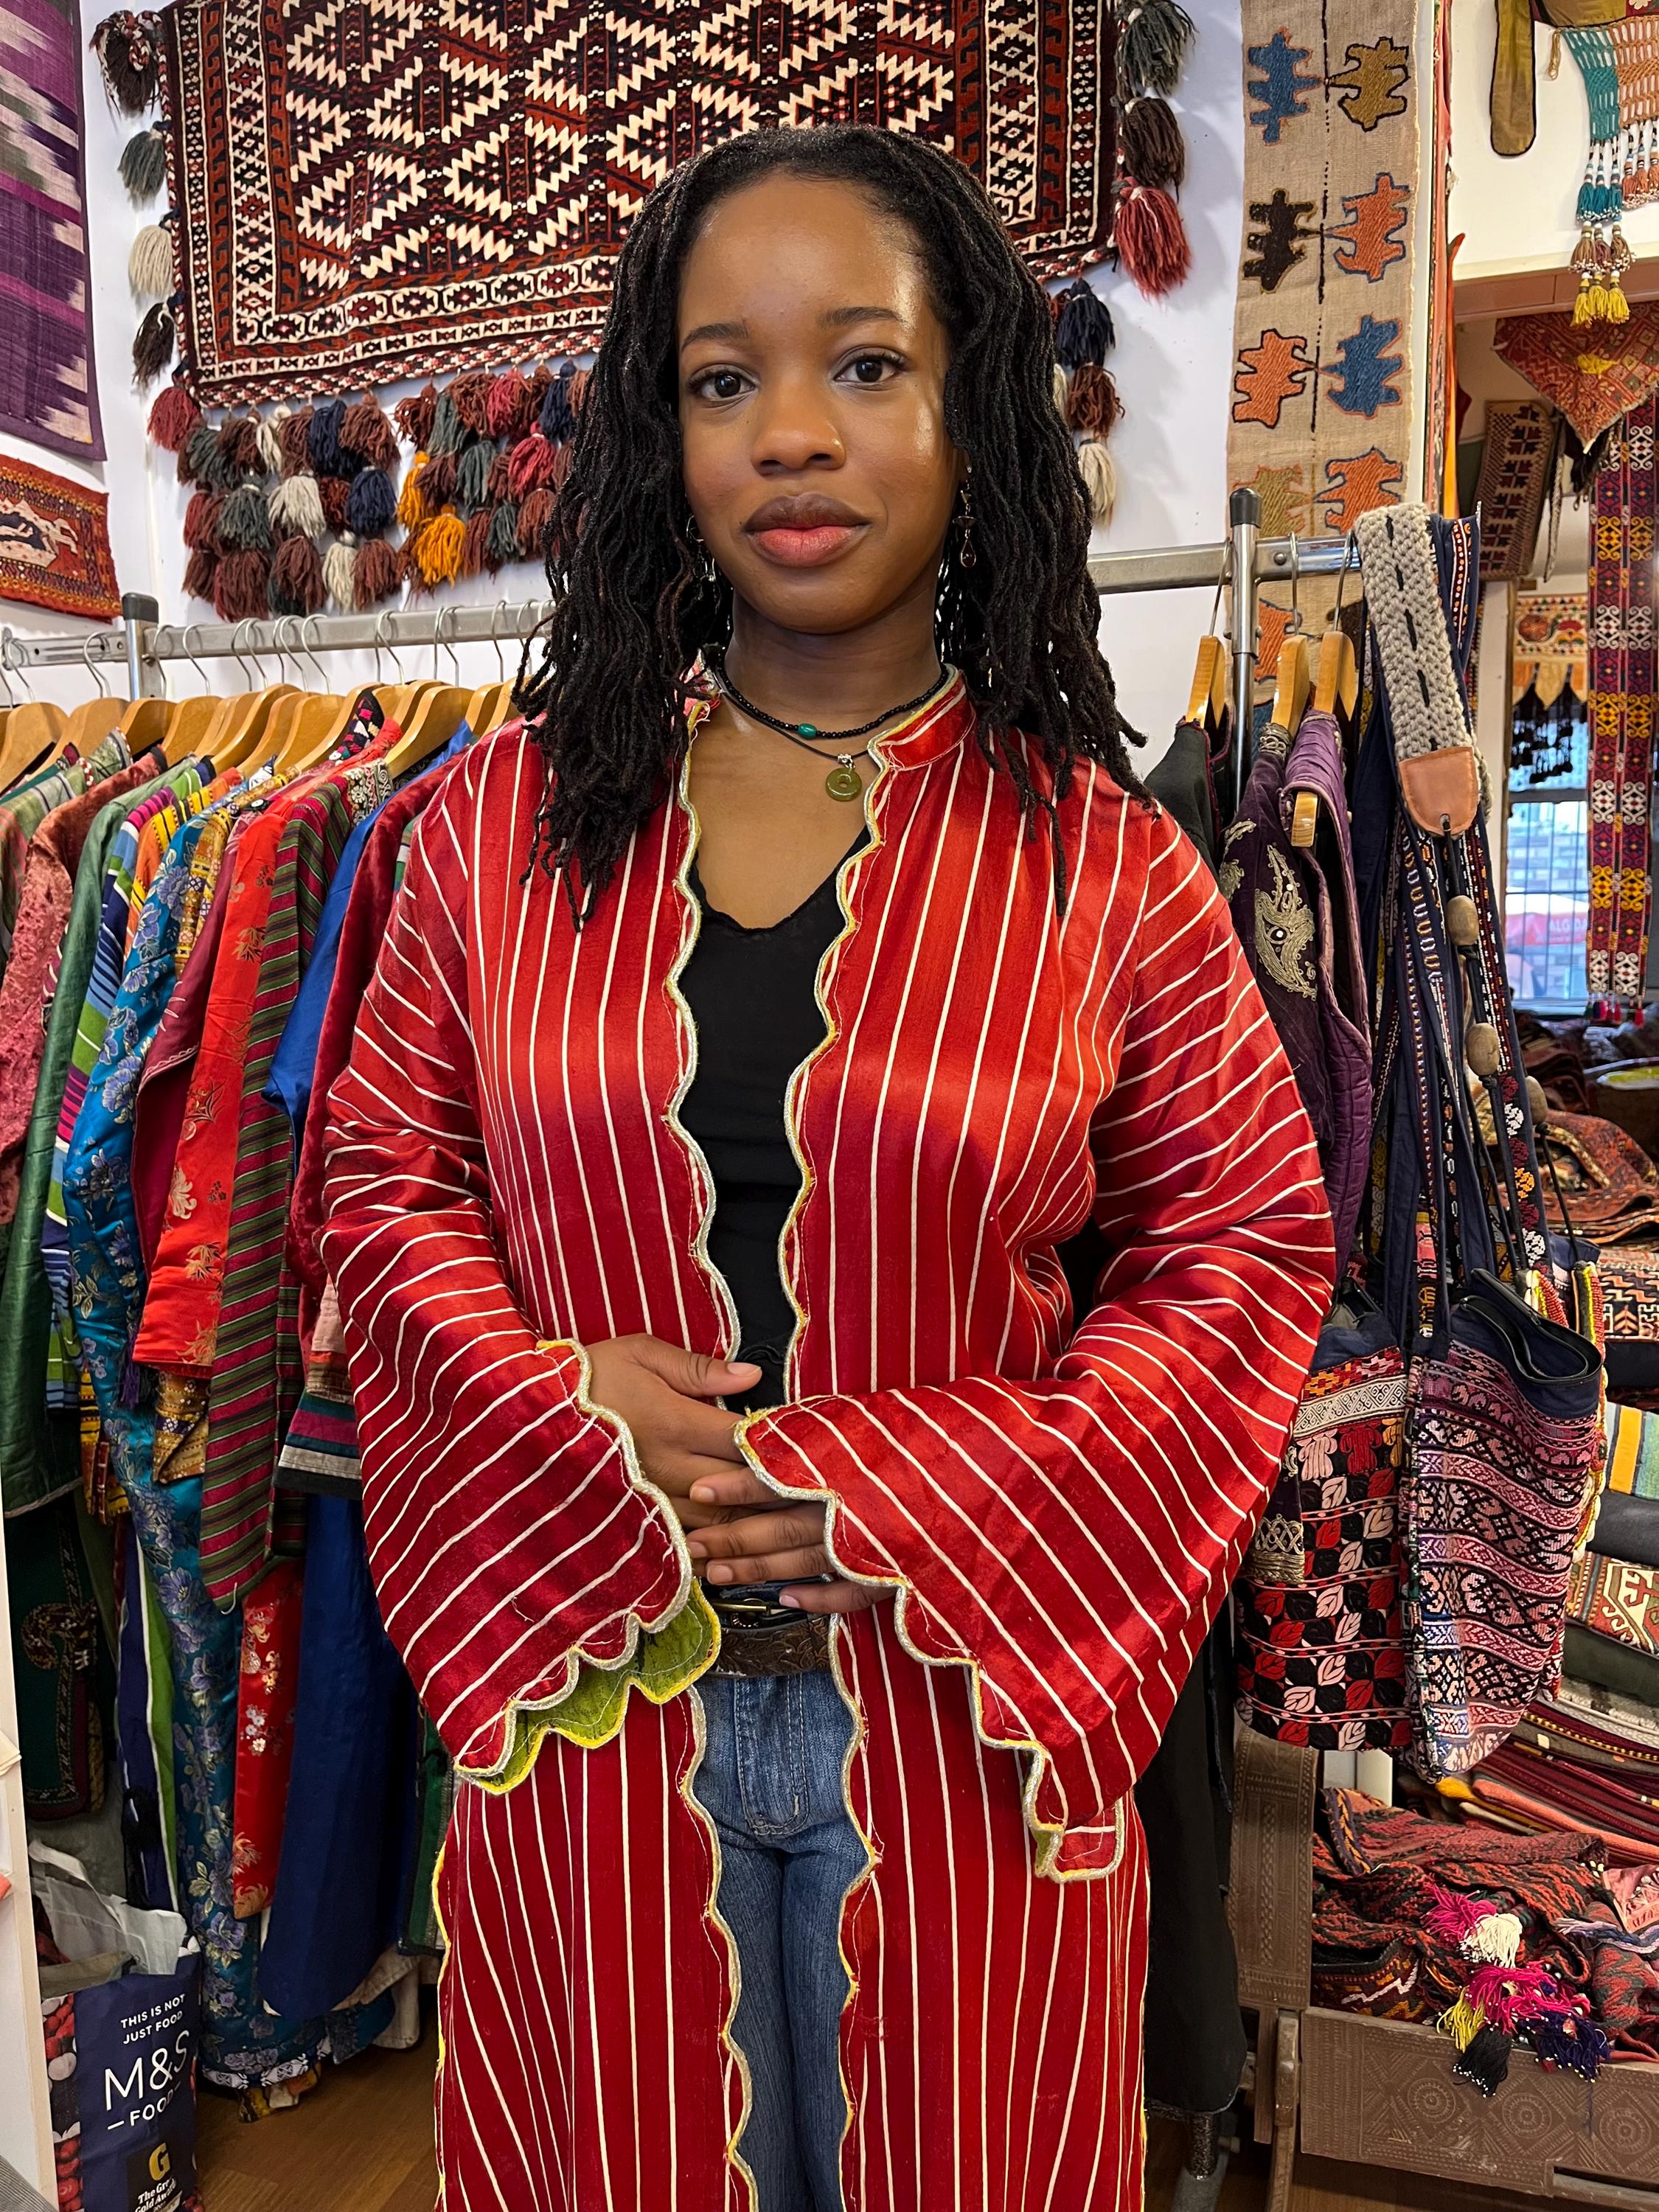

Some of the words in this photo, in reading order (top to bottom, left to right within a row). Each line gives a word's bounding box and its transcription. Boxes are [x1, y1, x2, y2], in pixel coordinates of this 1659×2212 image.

[1549, 918, 1587, 933] ALGDA
[120, 2011, 147, 2028] THIS
[150, 2006, 162, 2017] IS
[164, 1993, 185, 2011] NOT
[123, 2025, 152, 2045] JUST
[156, 2011, 183, 2031] FOOD
[105, 2030, 189, 2111] M&S
[149, 2142, 170, 2181] G
[135, 2197, 154, 2212] Gold
[138, 2189, 156, 2205] The
